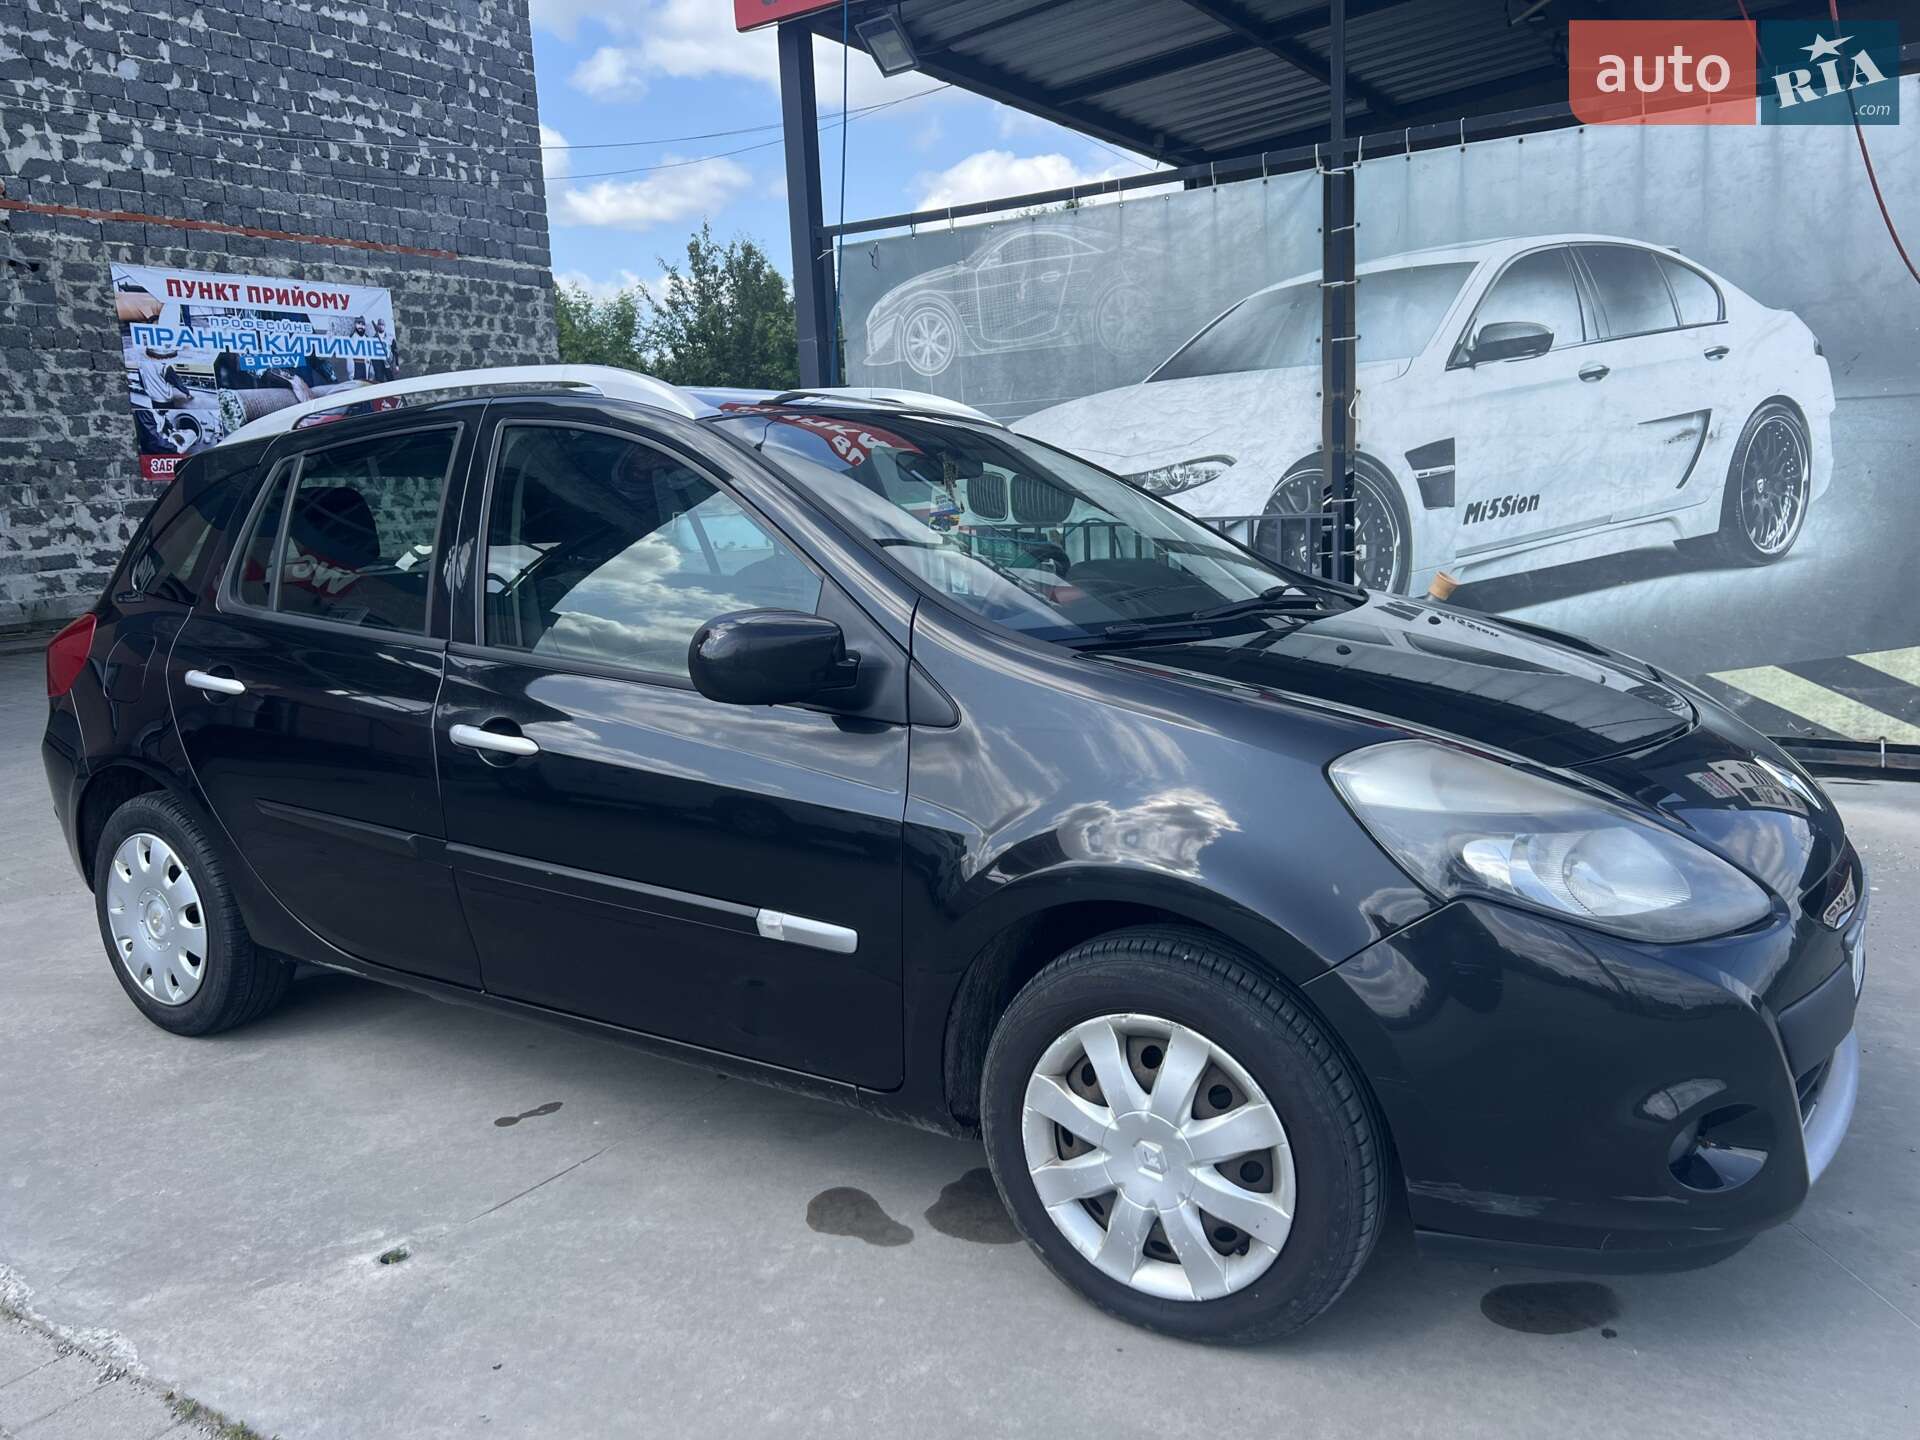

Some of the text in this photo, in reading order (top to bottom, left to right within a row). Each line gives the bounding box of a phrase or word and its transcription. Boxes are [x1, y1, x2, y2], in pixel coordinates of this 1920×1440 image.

[166, 278, 350, 311] ПУНКТ ПРИЙОМУ
[210, 317, 313, 333] ПРОФЕСІЙНЕ
[133, 326, 389, 358] ПРАННЯ КИЛИМІВ
[261, 355, 300, 368] цеху
[151, 459, 177, 473] ЗАБ
